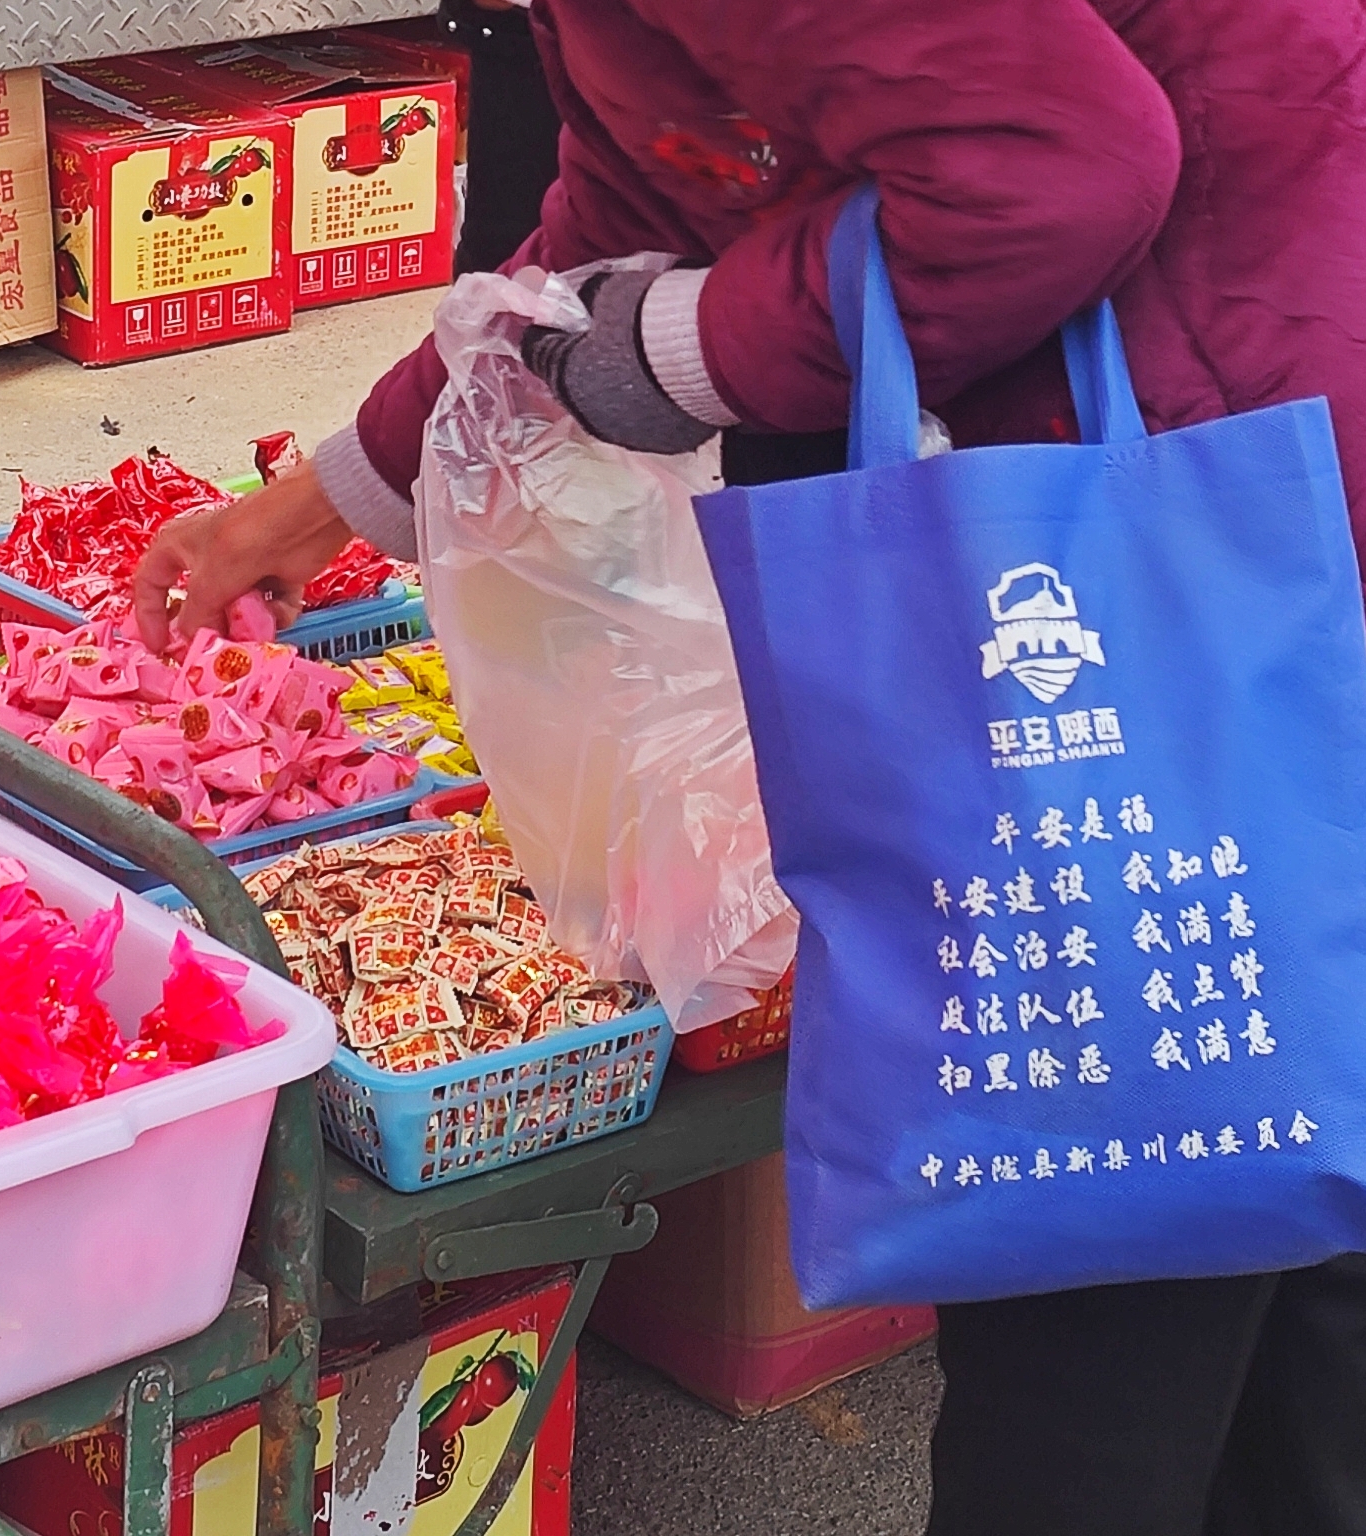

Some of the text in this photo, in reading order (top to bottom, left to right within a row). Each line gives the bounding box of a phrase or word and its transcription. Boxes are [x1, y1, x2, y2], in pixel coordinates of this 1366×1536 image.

[990, 740, 1126, 769] PINGAN SHAANXI
[991, 793, 1155, 856] 平安是福
[931, 834, 1249, 920] 平安建设 我知晓
[936, 890, 1257, 979] 社会治安 我满意
[939, 946, 1266, 1037] 政法队伍 我点赞
[937, 1008, 1278, 1097] 扫黑除恶 我满意
